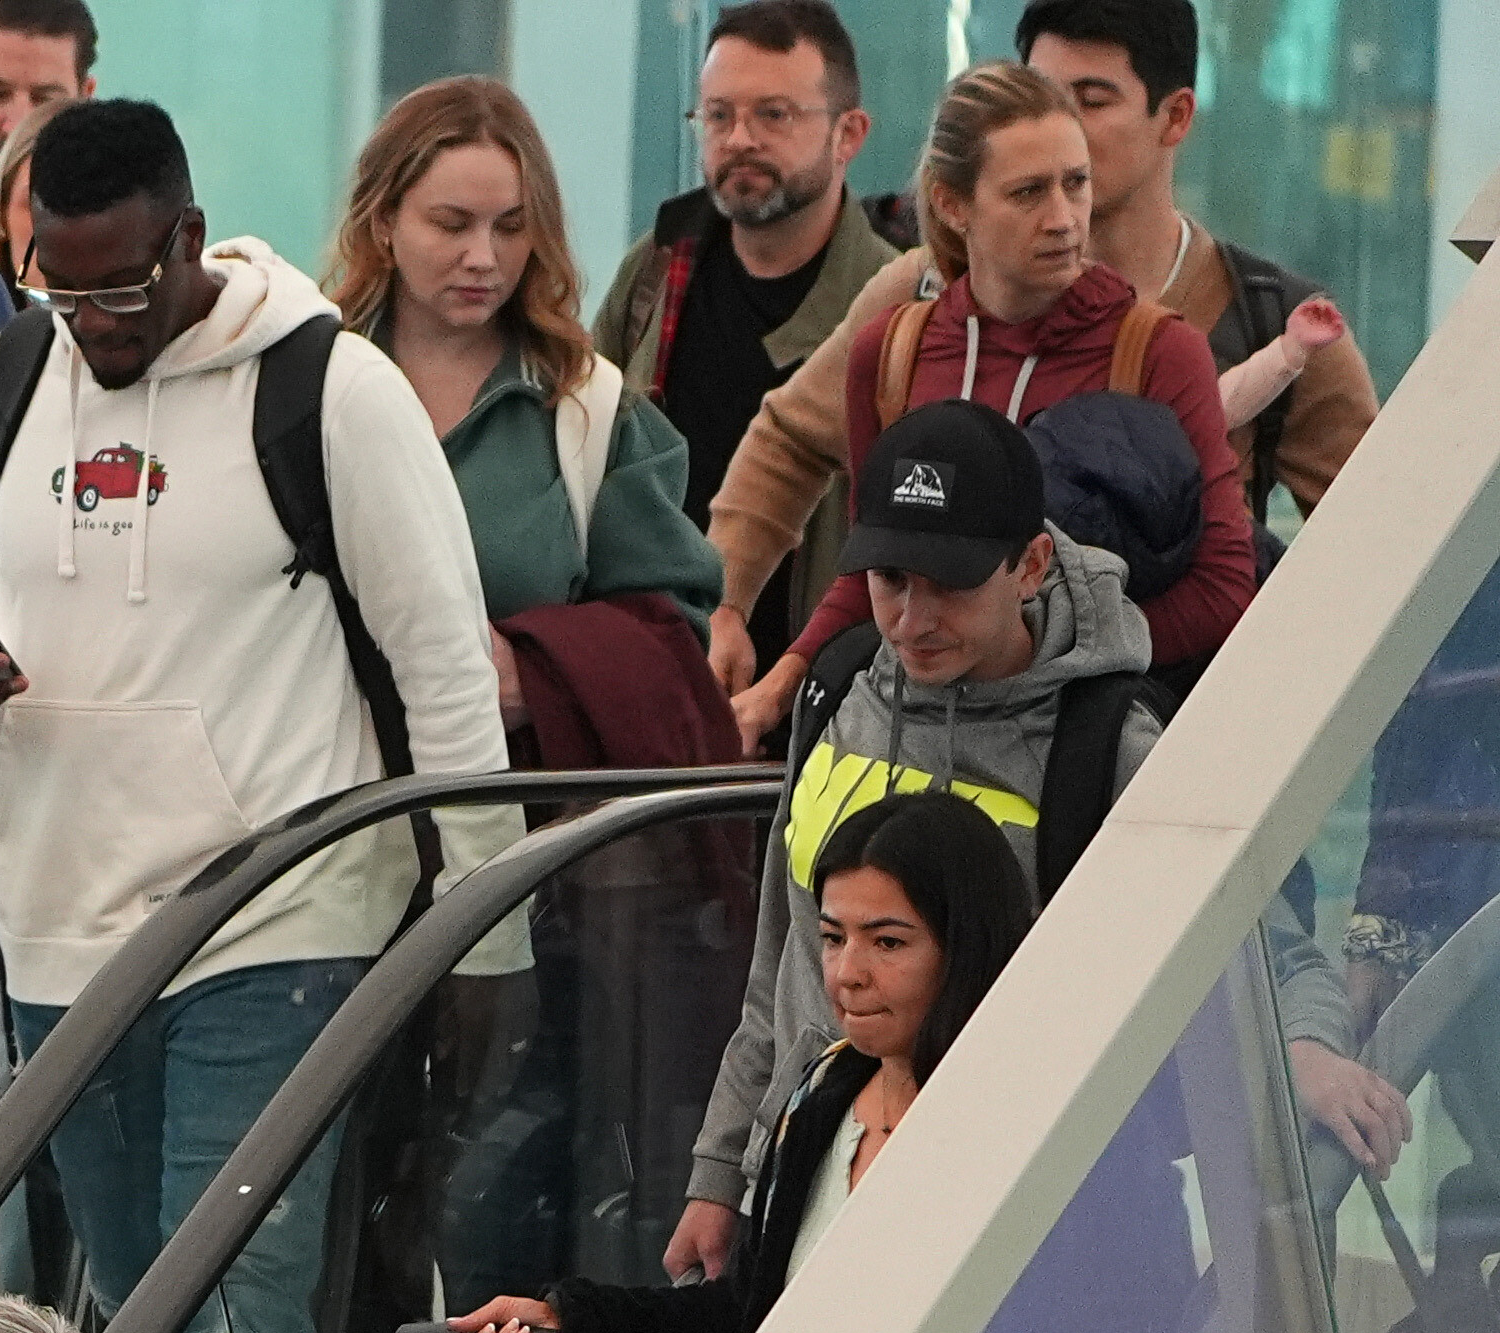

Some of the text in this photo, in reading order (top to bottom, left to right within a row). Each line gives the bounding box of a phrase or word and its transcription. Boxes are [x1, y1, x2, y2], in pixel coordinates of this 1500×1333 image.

[904, 497, 927, 505] NORTH
[927, 499, 944, 507] FACE
[73, 518, 95, 530] Life
[111, 522, 134, 536] goo
